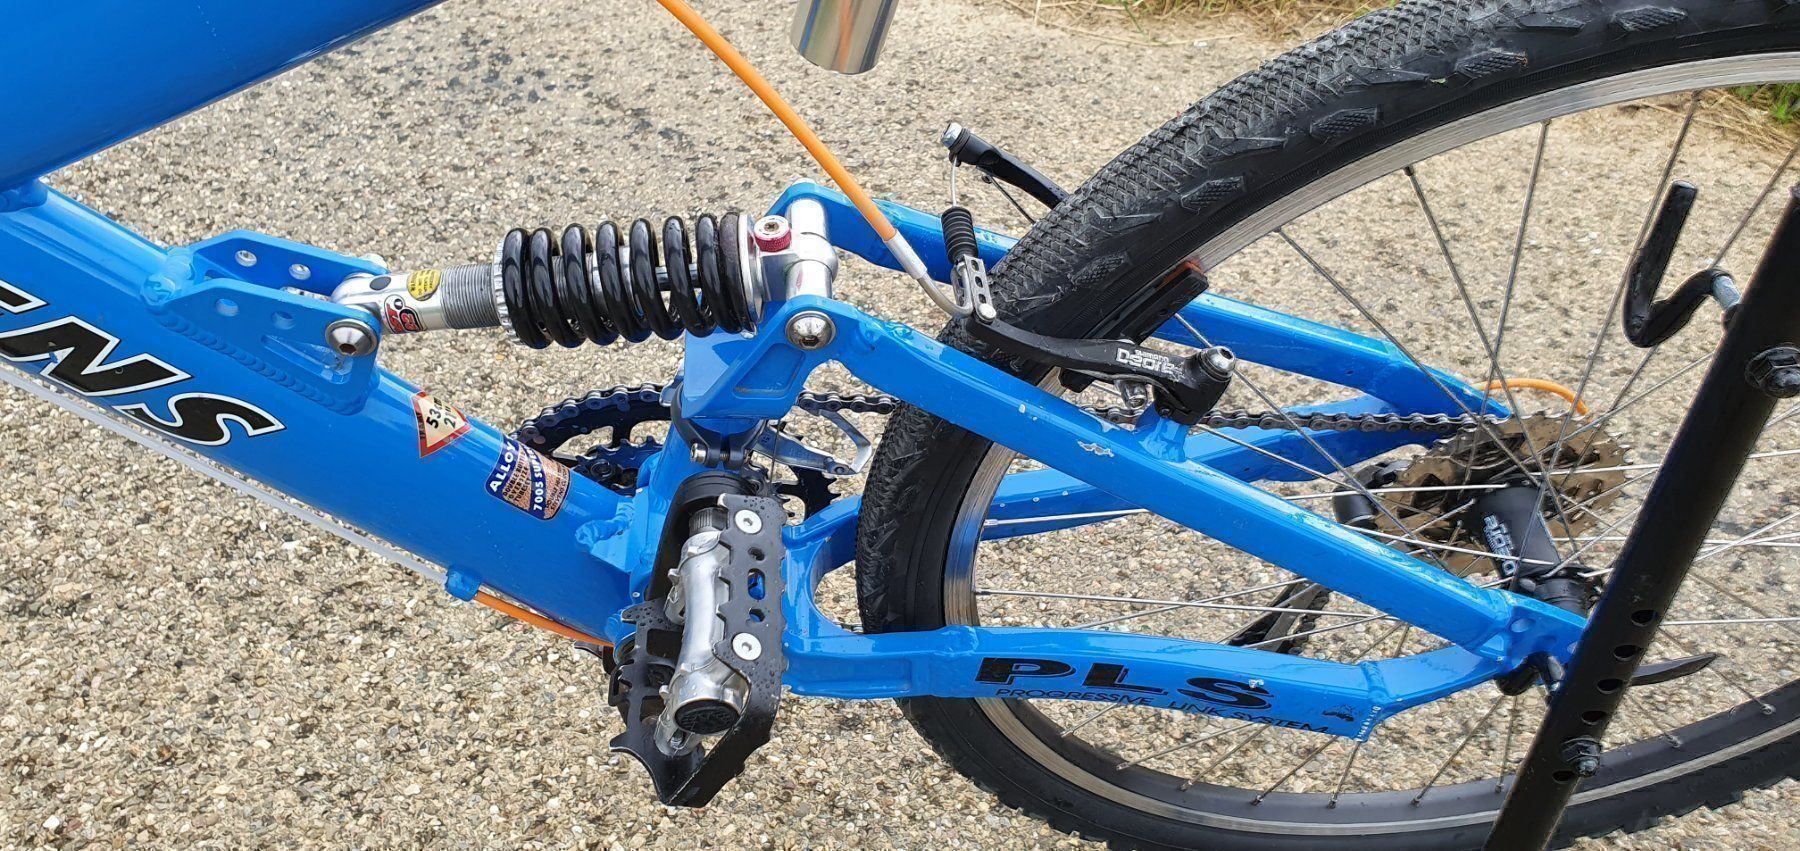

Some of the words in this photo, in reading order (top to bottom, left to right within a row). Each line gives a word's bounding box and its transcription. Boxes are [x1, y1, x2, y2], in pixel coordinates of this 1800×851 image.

[0, 280, 287, 446] NS
[489, 441, 516, 492] ALLOY
[502, 472, 518, 497] DOUBLE
[533, 482, 544, 511] 7005
[975, 657, 1275, 709] PLS
[995, 688, 1155, 706] PROGRESSIVE
[1169, 701, 1225, 716] LINK
[1233, 711, 1330, 734] SYSTEM
